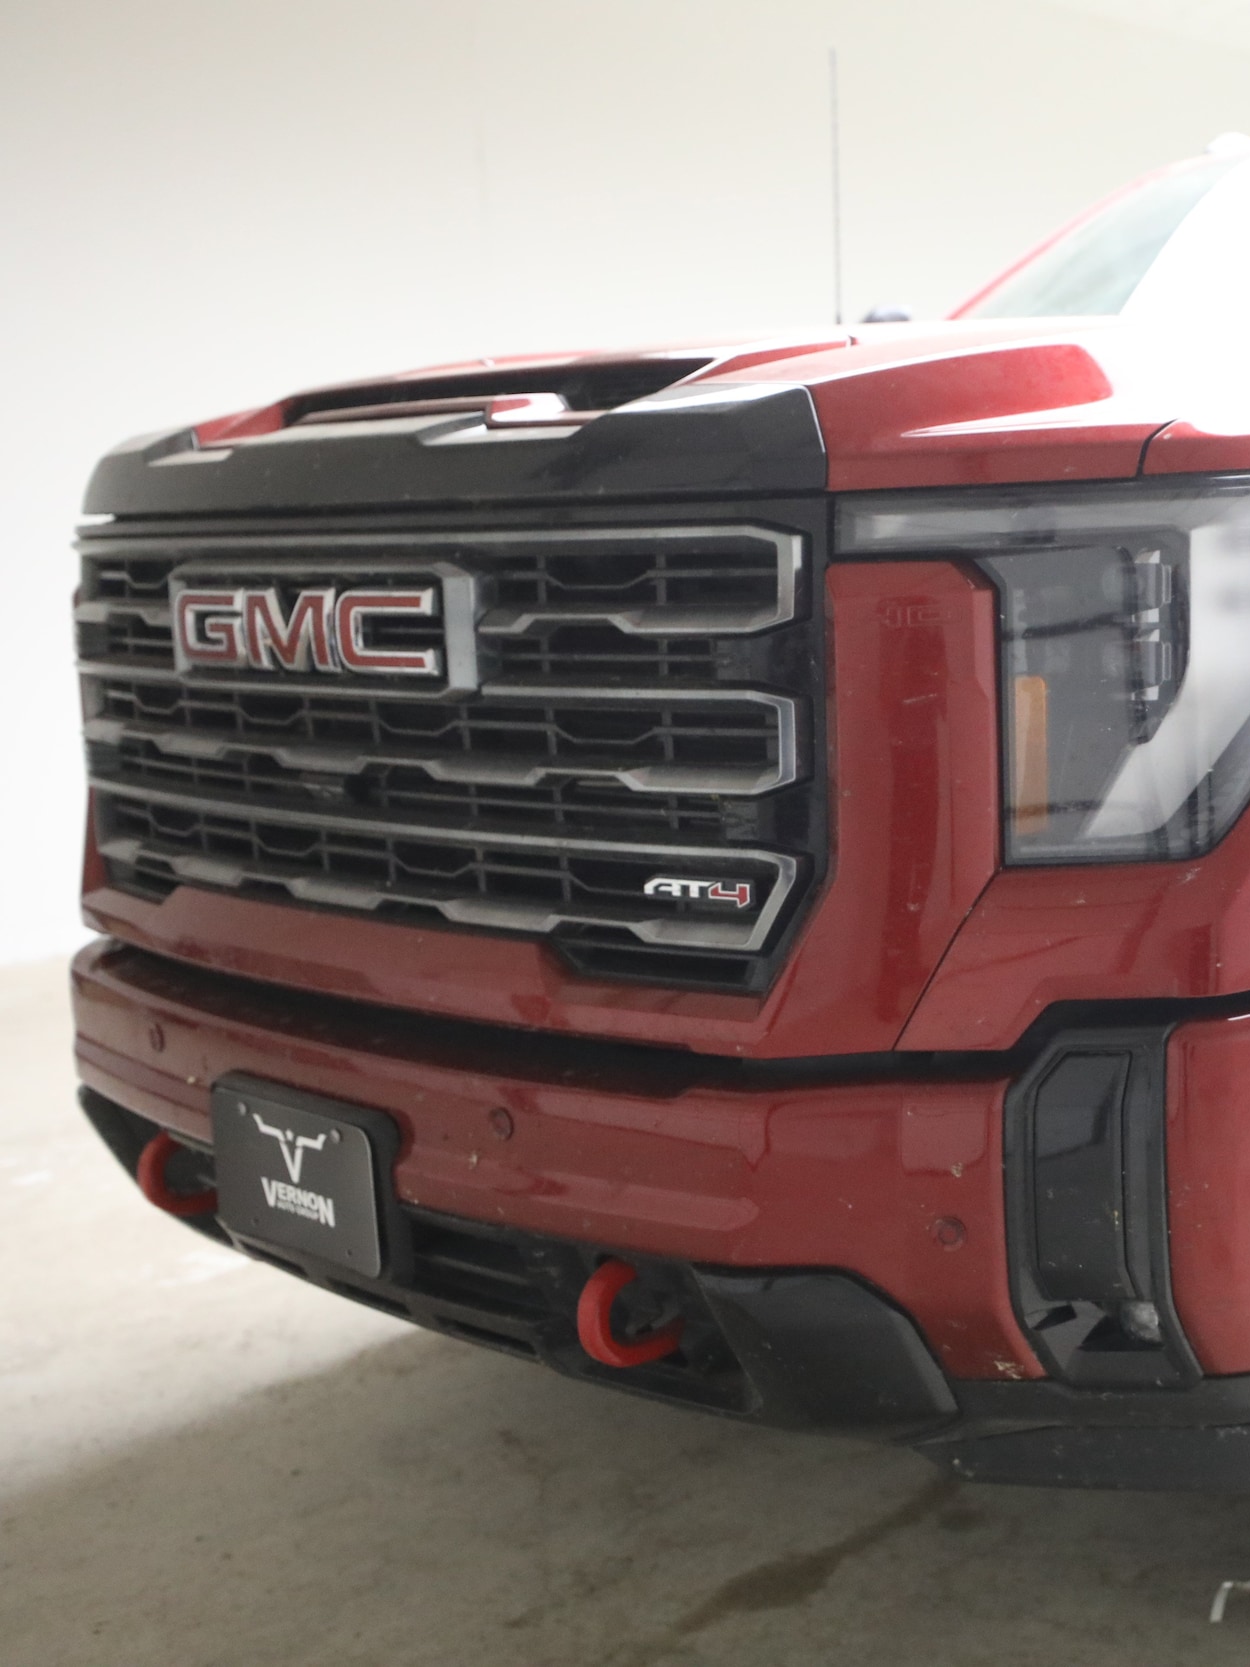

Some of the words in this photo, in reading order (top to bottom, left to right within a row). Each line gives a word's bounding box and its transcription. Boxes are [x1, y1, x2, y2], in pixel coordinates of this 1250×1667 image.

[174, 587, 439, 676] GMC
[643, 877, 750, 908] AT4
[260, 1176, 336, 1228] VERNON
